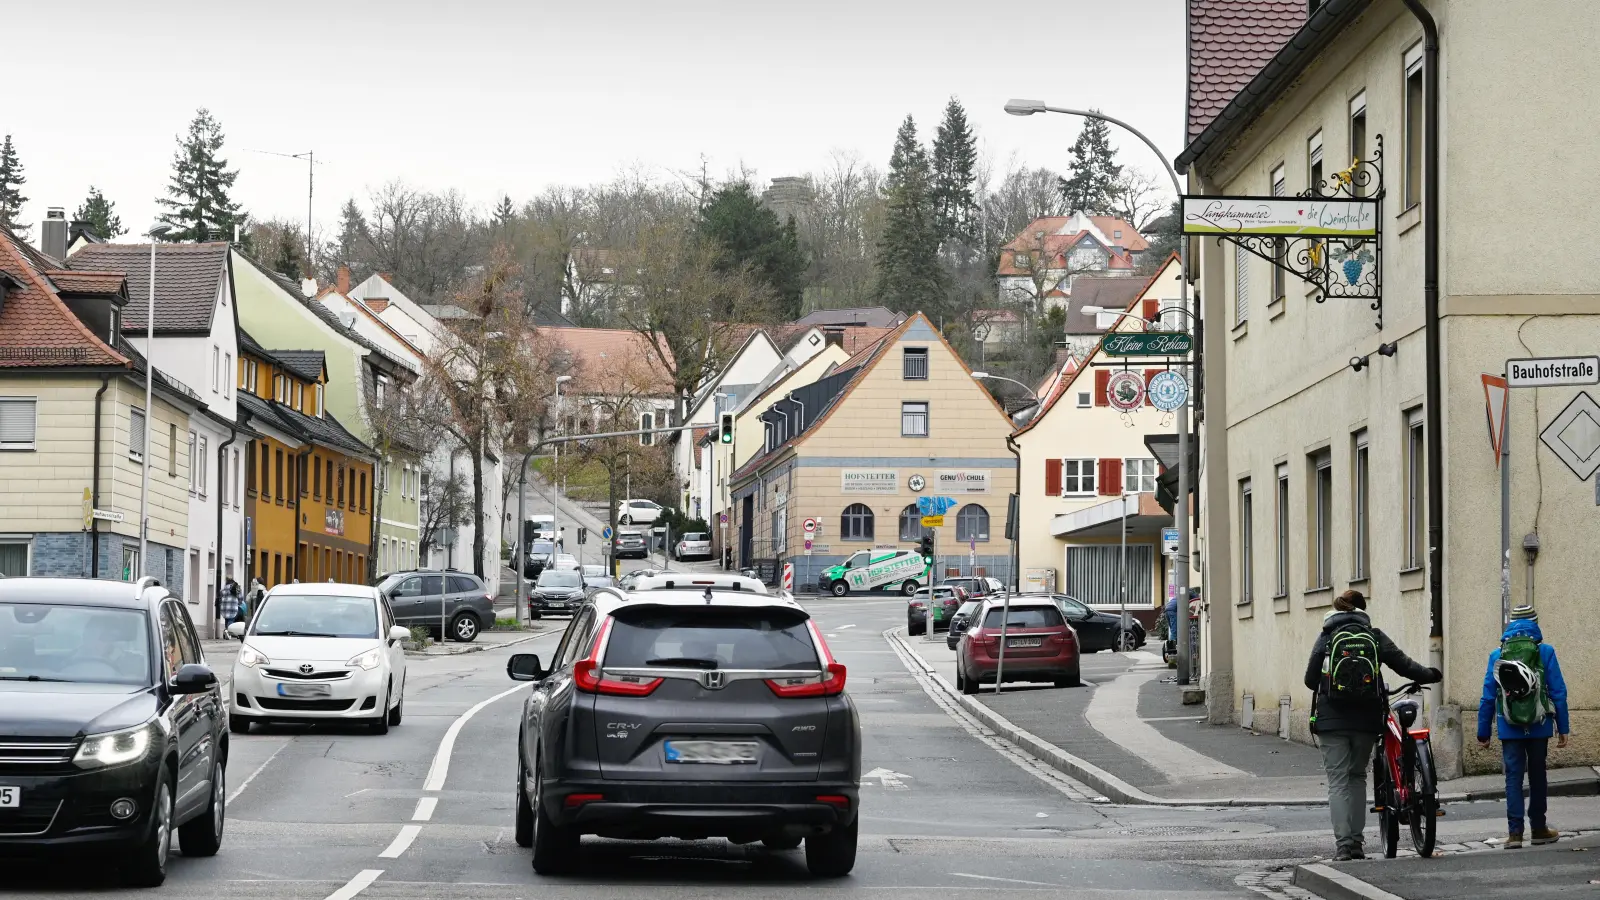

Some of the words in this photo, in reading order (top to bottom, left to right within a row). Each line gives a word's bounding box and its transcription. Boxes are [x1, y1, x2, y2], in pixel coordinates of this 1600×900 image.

[1307, 203, 1317, 219] die
[1319, 202, 1370, 232] Weinstraße
[1105, 335, 1143, 353] Kleine
[1146, 335, 1189, 353] Reblaus
[1512, 362, 1593, 379] Bauhofstraße
[868, 556, 920, 577] HOFSTETTER
[606, 722, 642, 730] CR-V
[0, 788, 12, 805] 5
